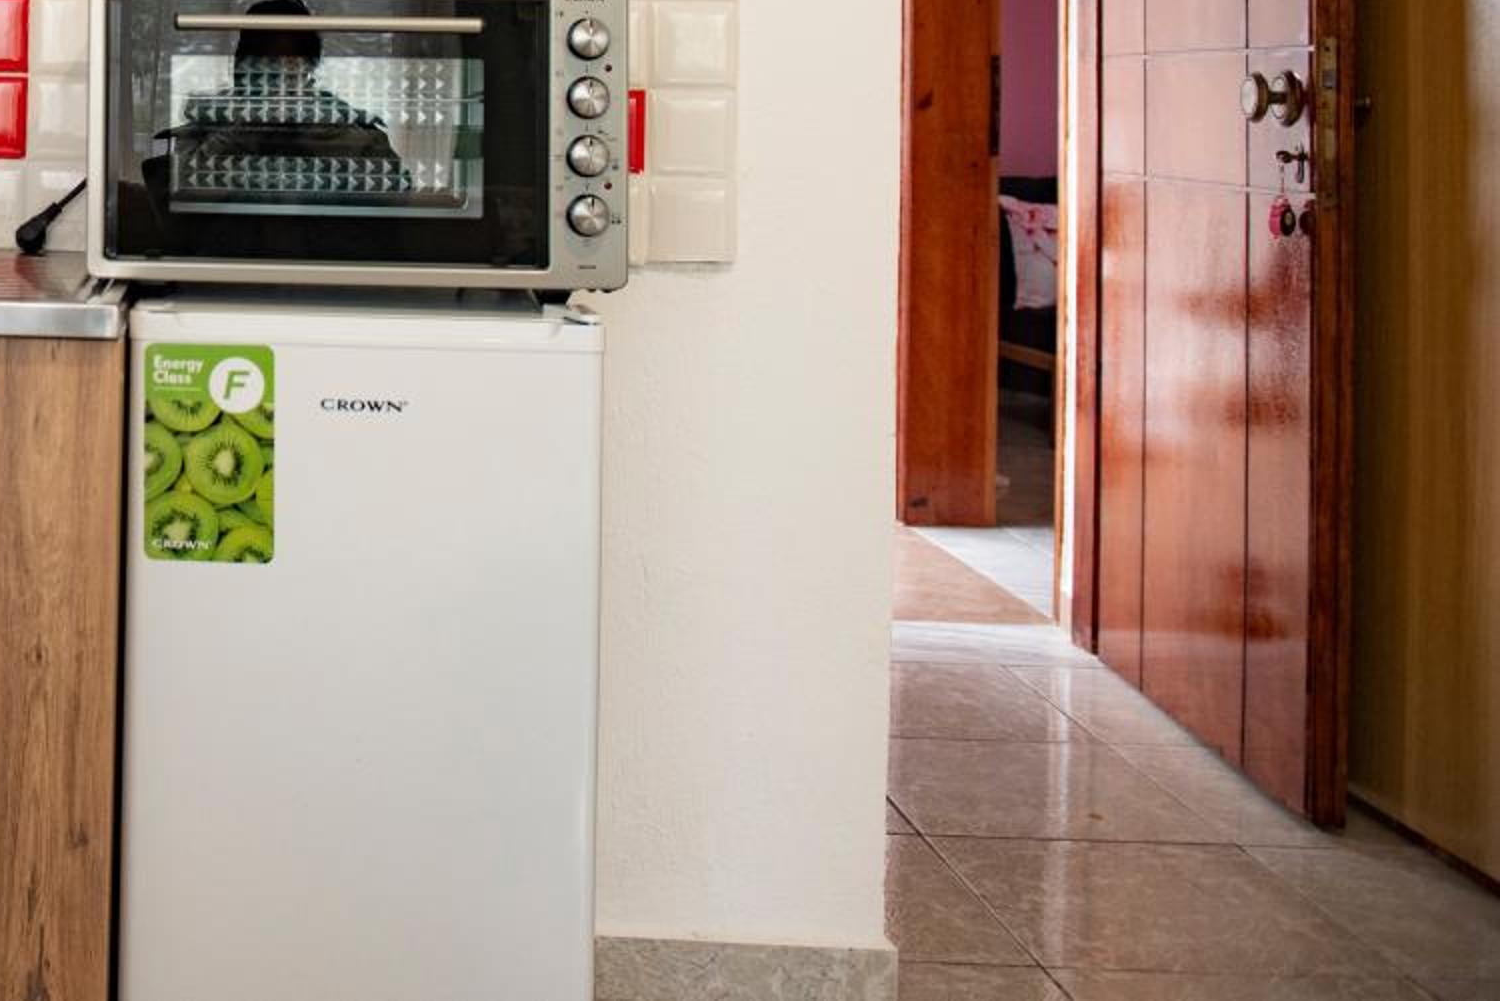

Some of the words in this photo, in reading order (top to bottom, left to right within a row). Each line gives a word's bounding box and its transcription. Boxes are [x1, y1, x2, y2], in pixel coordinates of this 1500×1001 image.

[153, 355, 203, 374] Energy
[153, 370, 192, 384] Class
[224, 370, 250, 399] F
[320, 398, 403, 413] CROWN
